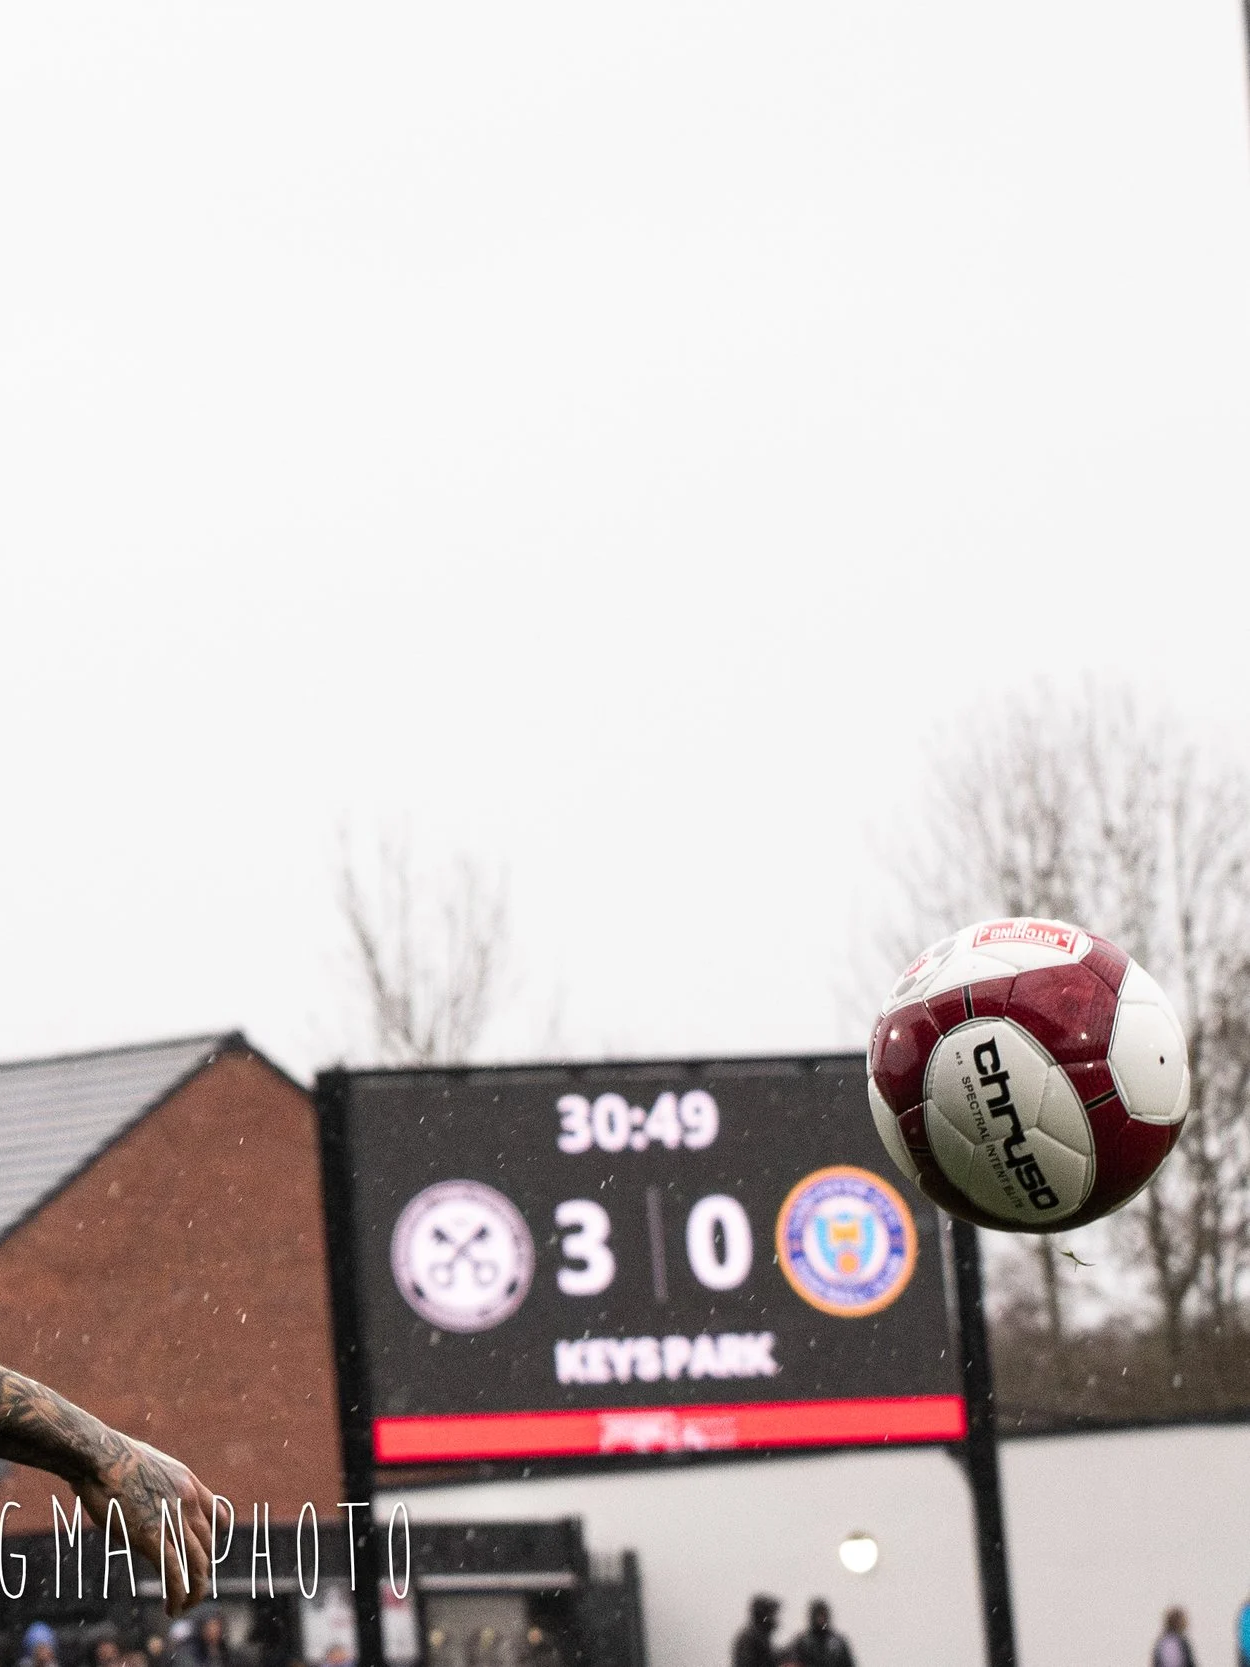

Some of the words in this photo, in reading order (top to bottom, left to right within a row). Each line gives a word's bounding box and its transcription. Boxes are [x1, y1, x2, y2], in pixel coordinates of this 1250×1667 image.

[556, 1090, 720, 1154] 30:49
[961, 1076, 991, 1139] SPECTRAL
[973, 1036, 1060, 1210] chryso
[555, 1199, 617, 1296] 3
[685, 1193, 754, 1292] 0
